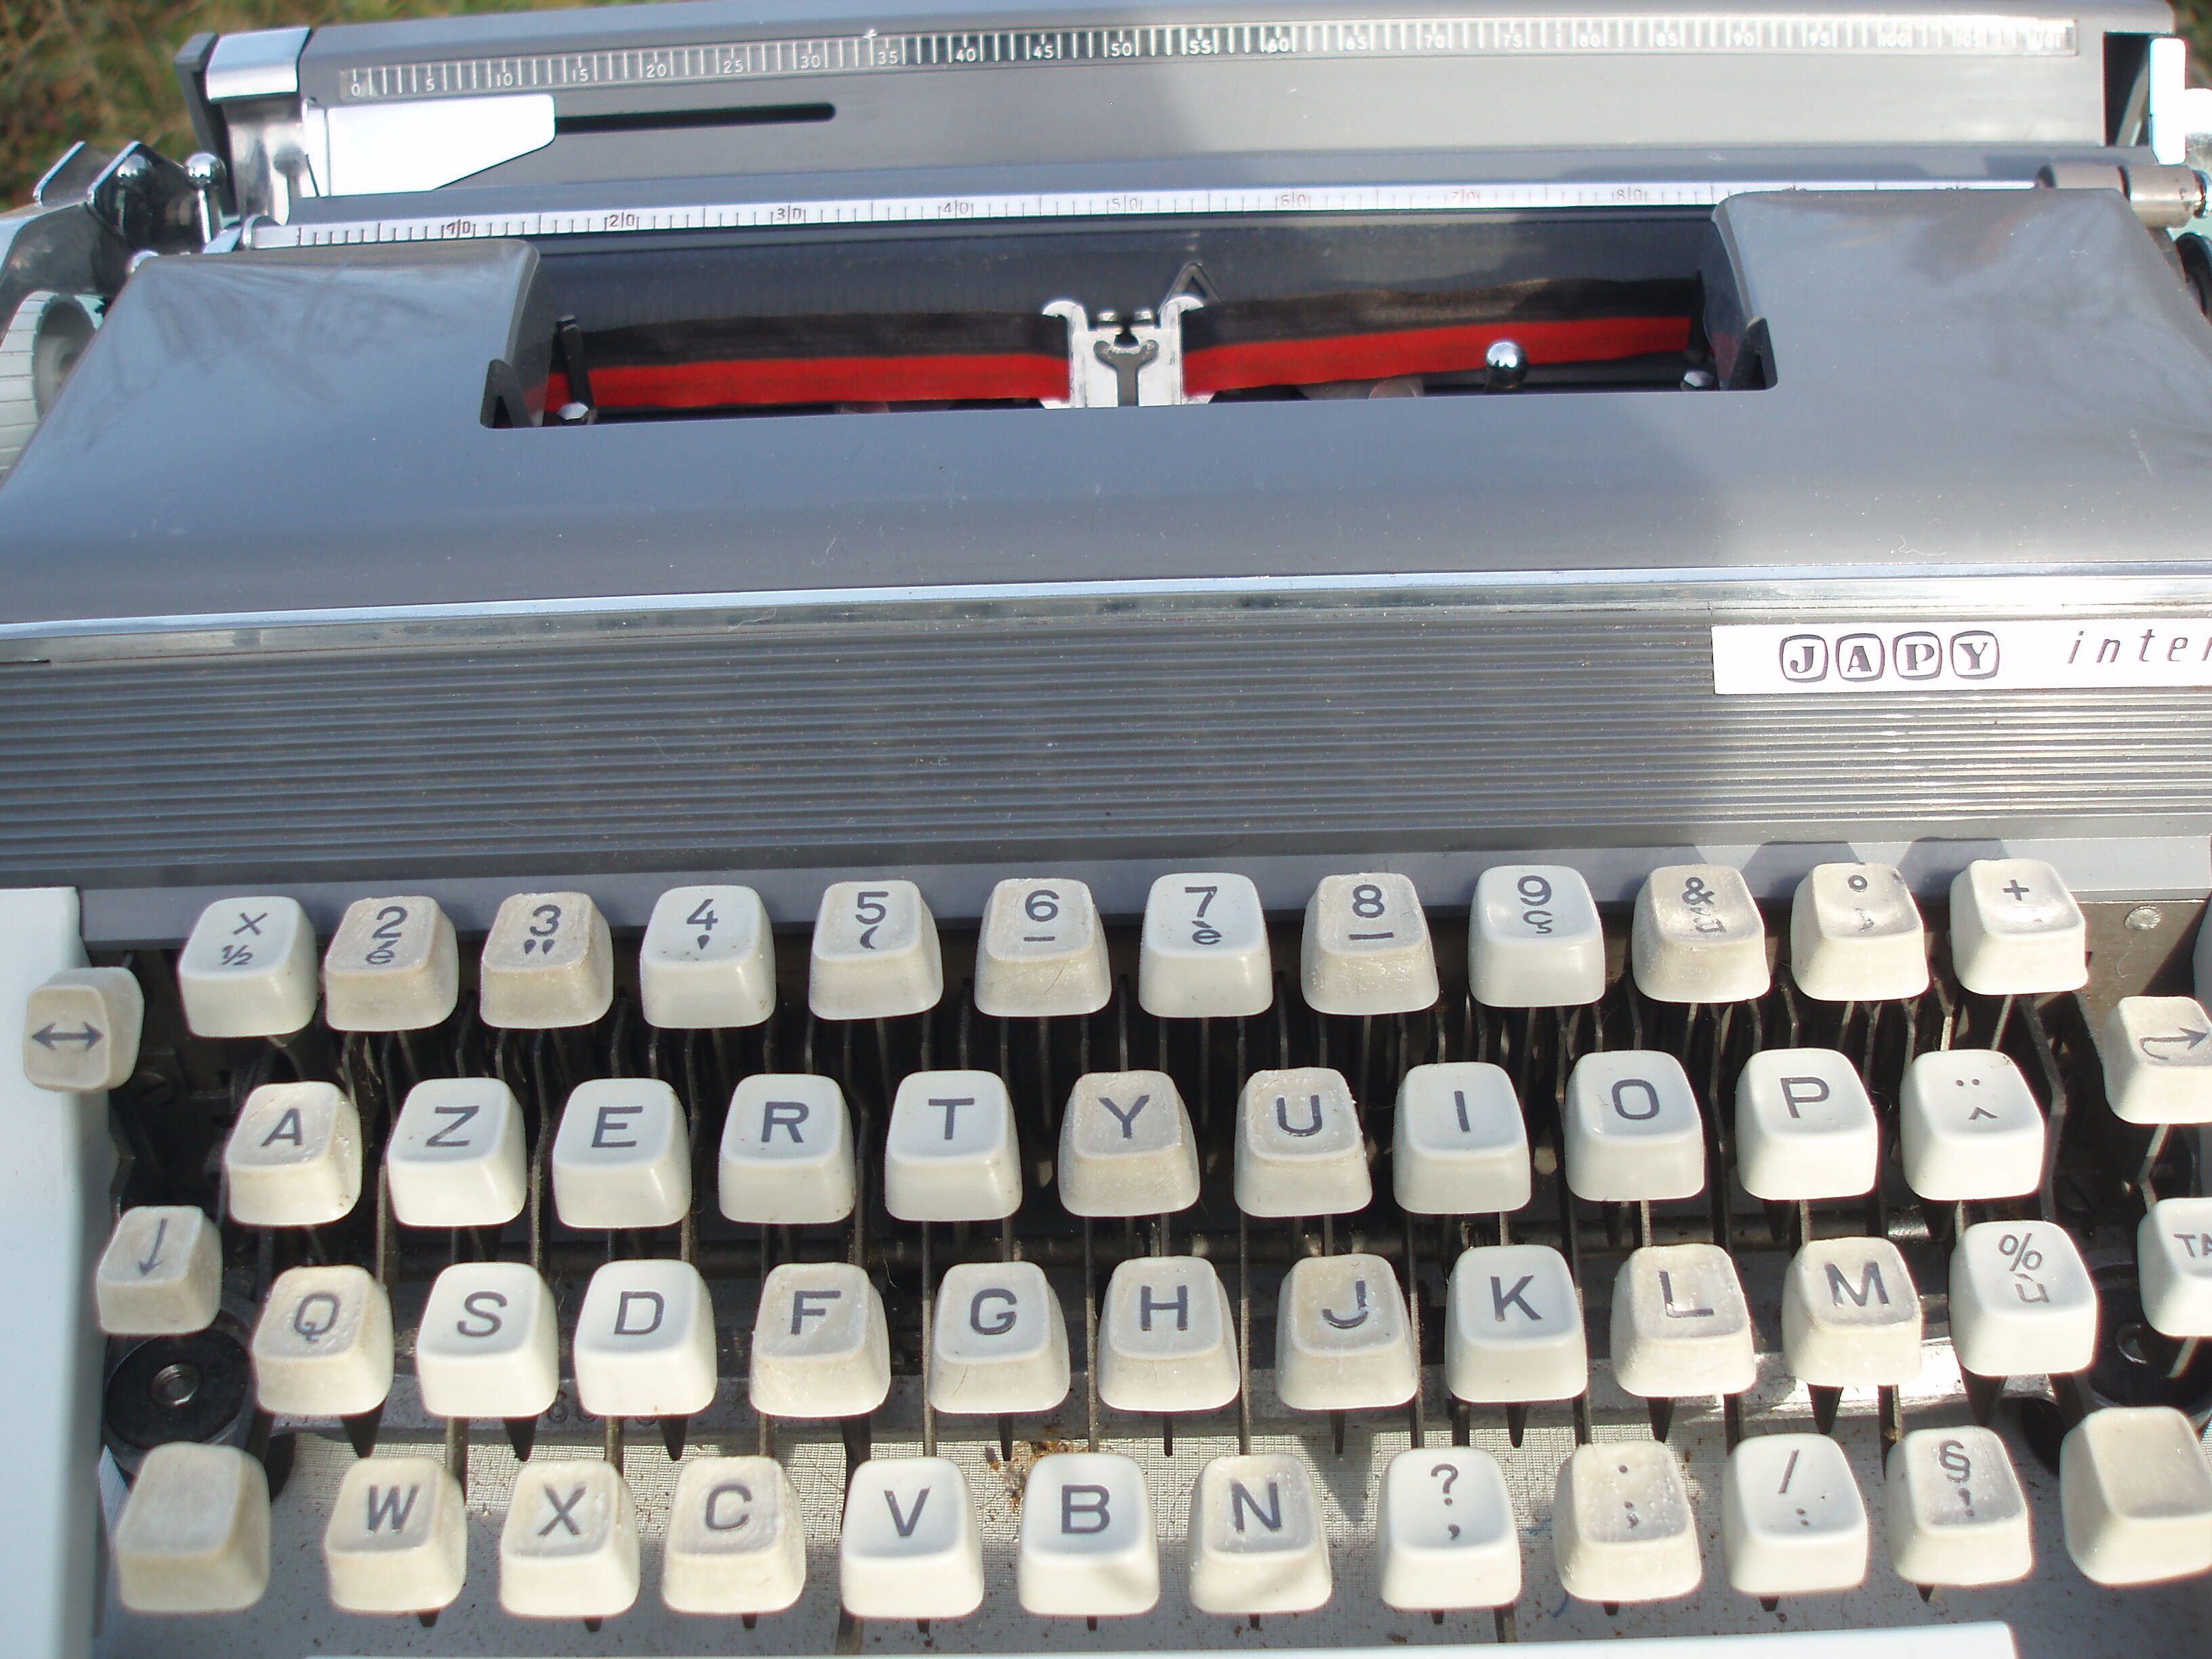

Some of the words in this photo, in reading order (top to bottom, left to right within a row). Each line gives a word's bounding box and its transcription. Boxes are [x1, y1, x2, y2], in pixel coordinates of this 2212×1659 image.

[351, 83, 361, 97] 0
[426, 78, 435, 92] 5
[497, 73, 514, 87] 10
[572, 68, 589, 82] 15
[646, 64, 667, 79] 20
[723, 60, 744, 75] 25
[800, 55, 821, 69] 30
[878, 52, 899, 65] 35
[955, 47, 977, 62] 40
[1033, 44, 1055, 59] 45
[1111, 43, 1133, 57] 50
[1189, 41, 1212, 54] 55
[1268, 39, 1289, 53] 60
[1786, 639, 1991, 676] JAPY
[855, 891, 888, 924] 5
[1025, 889, 1059, 922] 6
[1185, 885, 1218, 918] 7
[1352, 884, 1385, 918] 8
[1517, 875, 1552, 907] 9
[1681, 876, 1715, 905] &
[371, 905, 407, 939] 2
[529, 904, 560, 937] 3
[687, 898, 720, 931] 4
[928, 1097, 975, 1141] T
[1098, 1094, 1150, 1140] Y
[1276, 1094, 1323, 1137] U
[1454, 1090, 1471, 1134] I
[1611, 1079, 1660, 1121] O
[1780, 1076, 1830, 1119] P
[260, 1108, 303, 1147] A
[426, 1105, 480, 1147] Z
[591, 1105, 643, 1149] E
[760, 1101, 809, 1143] R
[1997, 1232, 2043, 1272] %
[1322, 1280, 1368, 1330] J
[1490, 1275, 1542, 1322] K
[1658, 1271, 1715, 1317] L
[1824, 1261, 1890, 1307] M
[292, 1292, 340, 1344] Q
[457, 1291, 508, 1338] S
[613, 1291, 665, 1336] D
[790, 1290, 842, 1336] F
[970, 1288, 1017, 1336] G
[1140, 1285, 1188, 1332] H
[1231, 1481, 1283, 1533] N
[1429, 1463, 1459, 1507] ?
[367, 1486, 417, 1532] W
[537, 1487, 586, 1537] X
[705, 1483, 753, 1532] C
[884, 1488, 930, 1538] V
[1061, 1485, 1111, 1535] B
